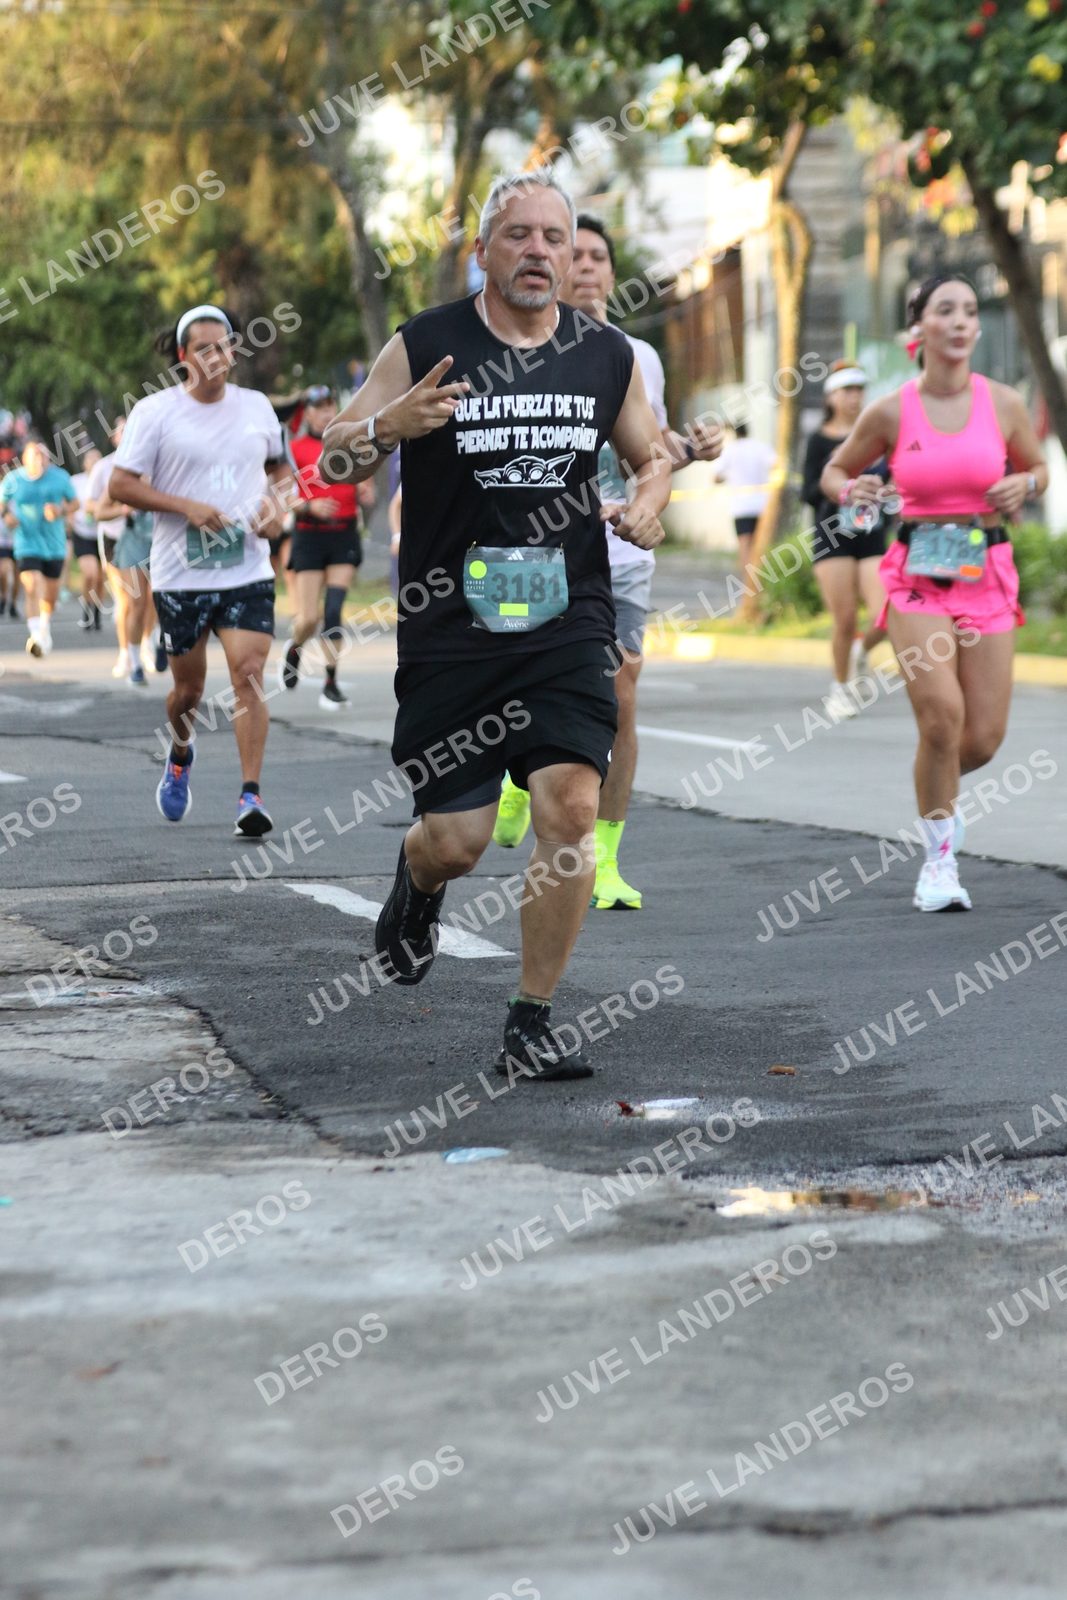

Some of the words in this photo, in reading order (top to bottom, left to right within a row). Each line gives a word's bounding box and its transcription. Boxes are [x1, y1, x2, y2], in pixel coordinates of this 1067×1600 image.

[454, 397, 481, 422] QUE
[483, 395, 501, 419] LA
[503, 393, 553, 419] FUERZA
[555, 394, 572, 418] DE
[573, 395, 596, 420] TUS
[455, 427, 511, 454] PIERNAS
[513, 426, 530, 450] TE
[490, 572, 564, 604] 3181
